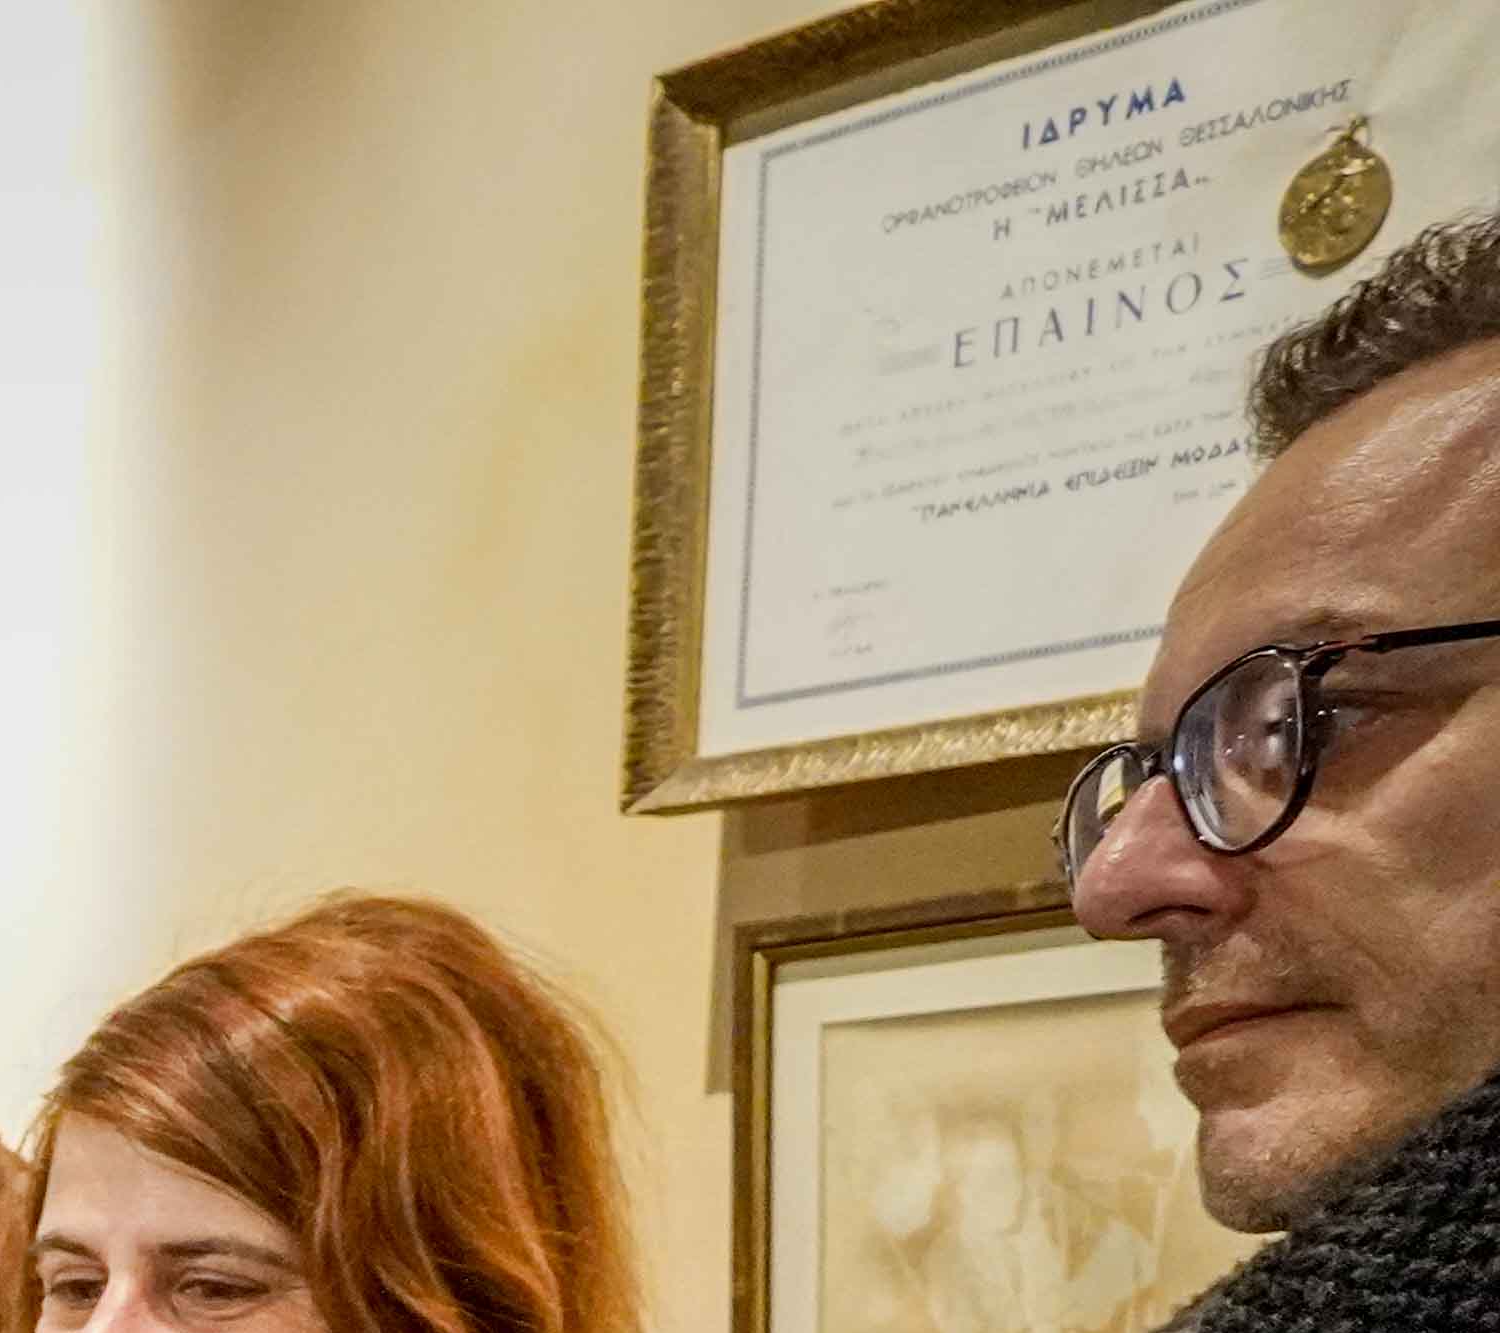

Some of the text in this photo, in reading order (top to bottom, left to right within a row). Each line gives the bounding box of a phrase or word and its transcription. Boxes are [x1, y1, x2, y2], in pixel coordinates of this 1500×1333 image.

[1020, 77, 1187, 150] ΙΔΡΥΜΑ
[1179, 78, 1353, 148] ΘΕΣΣΑΛΟΝΙΚΗΣ
[993, 218, 1012, 241] Η
[999, 234, 1200, 301] ΑΠΟΝΕΜΕΤΑΙ
[954, 257, 1248, 368] ΕΠΑΙΝΟΣ
